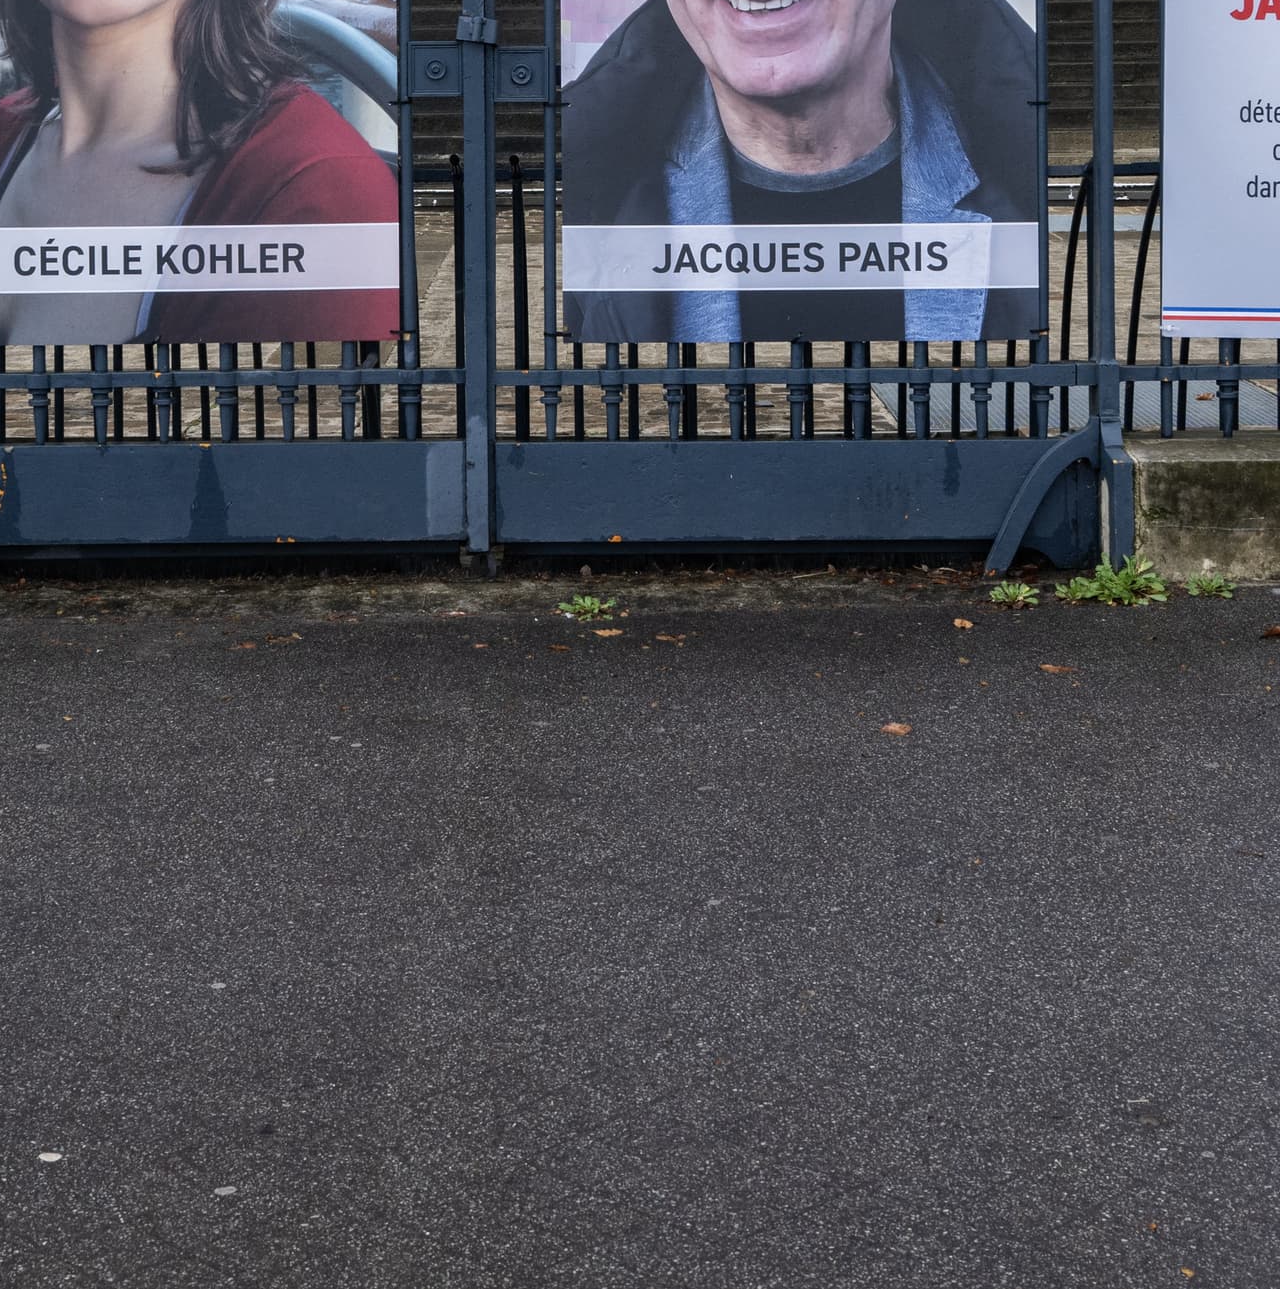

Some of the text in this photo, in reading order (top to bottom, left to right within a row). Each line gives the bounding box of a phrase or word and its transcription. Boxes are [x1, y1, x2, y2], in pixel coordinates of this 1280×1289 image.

[14, 238, 306, 276] CÉCILE KOHLER
[652, 241, 948, 274] JACQUES PARIS
